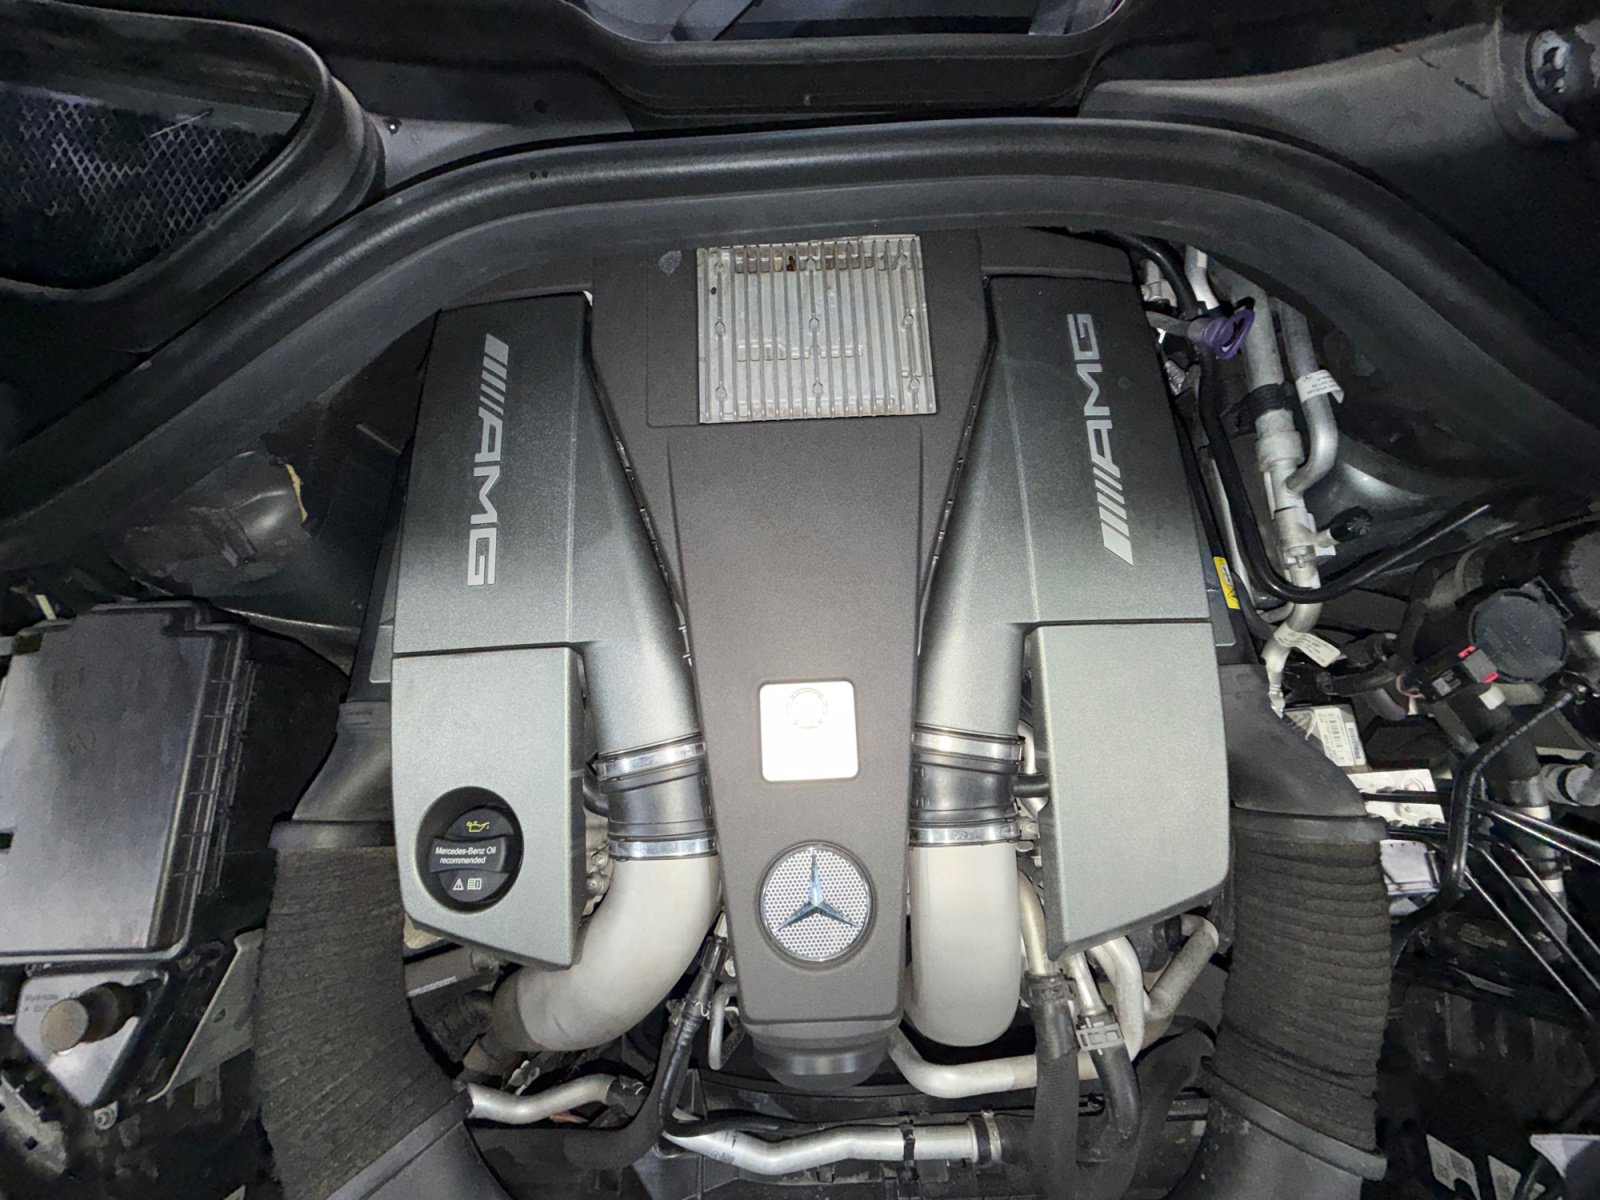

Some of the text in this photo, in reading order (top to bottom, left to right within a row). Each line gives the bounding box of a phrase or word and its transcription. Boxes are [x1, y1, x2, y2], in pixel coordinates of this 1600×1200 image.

[1067, 313, 1121, 480] AMG
[467, 404, 504, 587] AMG
[435, 846, 497, 855] Mercedes-Benz Oil
[440, 856, 487, 865] recommended
